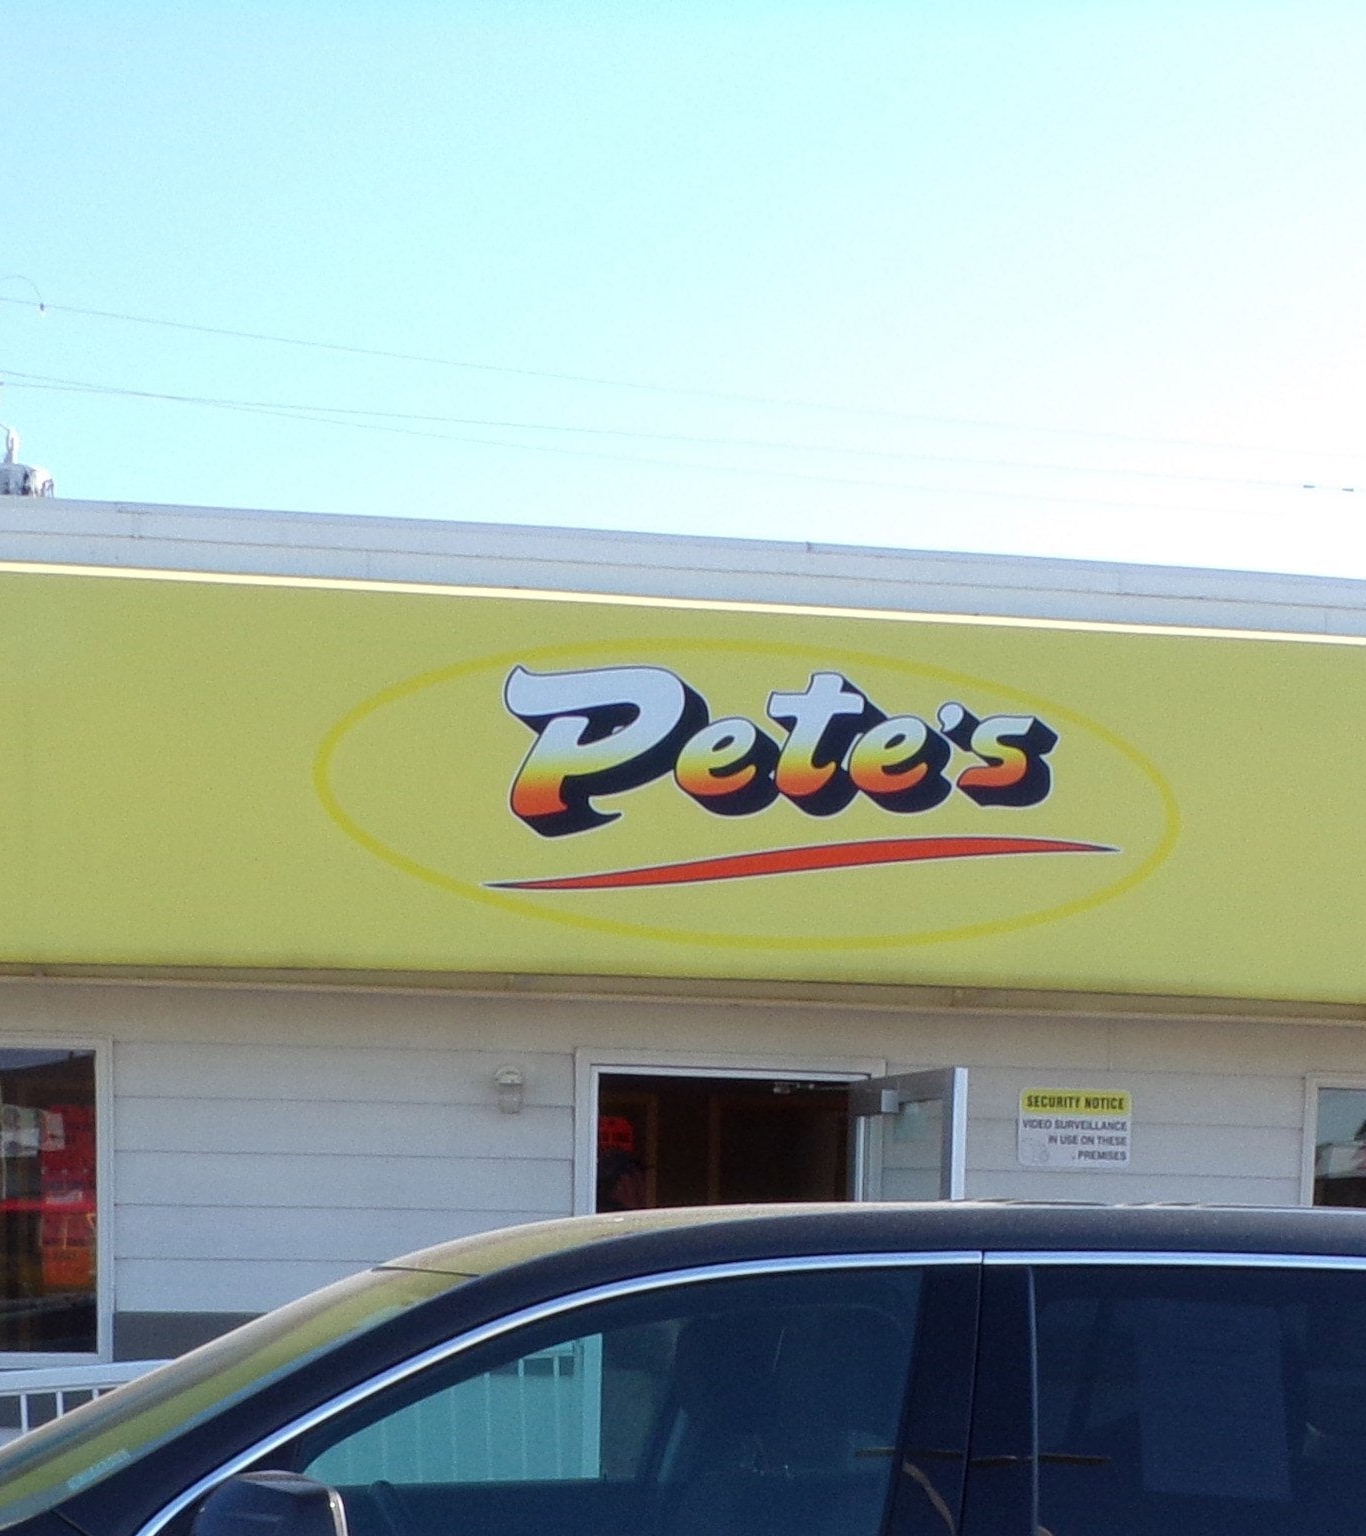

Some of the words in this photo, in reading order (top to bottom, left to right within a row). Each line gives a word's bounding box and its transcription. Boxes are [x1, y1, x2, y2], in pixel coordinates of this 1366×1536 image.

[504, 664, 1058, 839] Pete's
[1026, 1095, 1080, 1109] SECURITY
[1084, 1096, 1124, 1110] NOTICE
[1022, 1119, 1052, 1129] VIDEO
[1054, 1119, 1127, 1131] SURVEILLANCE
[1048, 1135, 1058, 1144] IN
[1060, 1135, 1078, 1145] USE
[1080, 1135, 1095, 1145] ON
[1097, 1136, 1127, 1146] THESE
[1077, 1150, 1127, 1161] PREMISES
